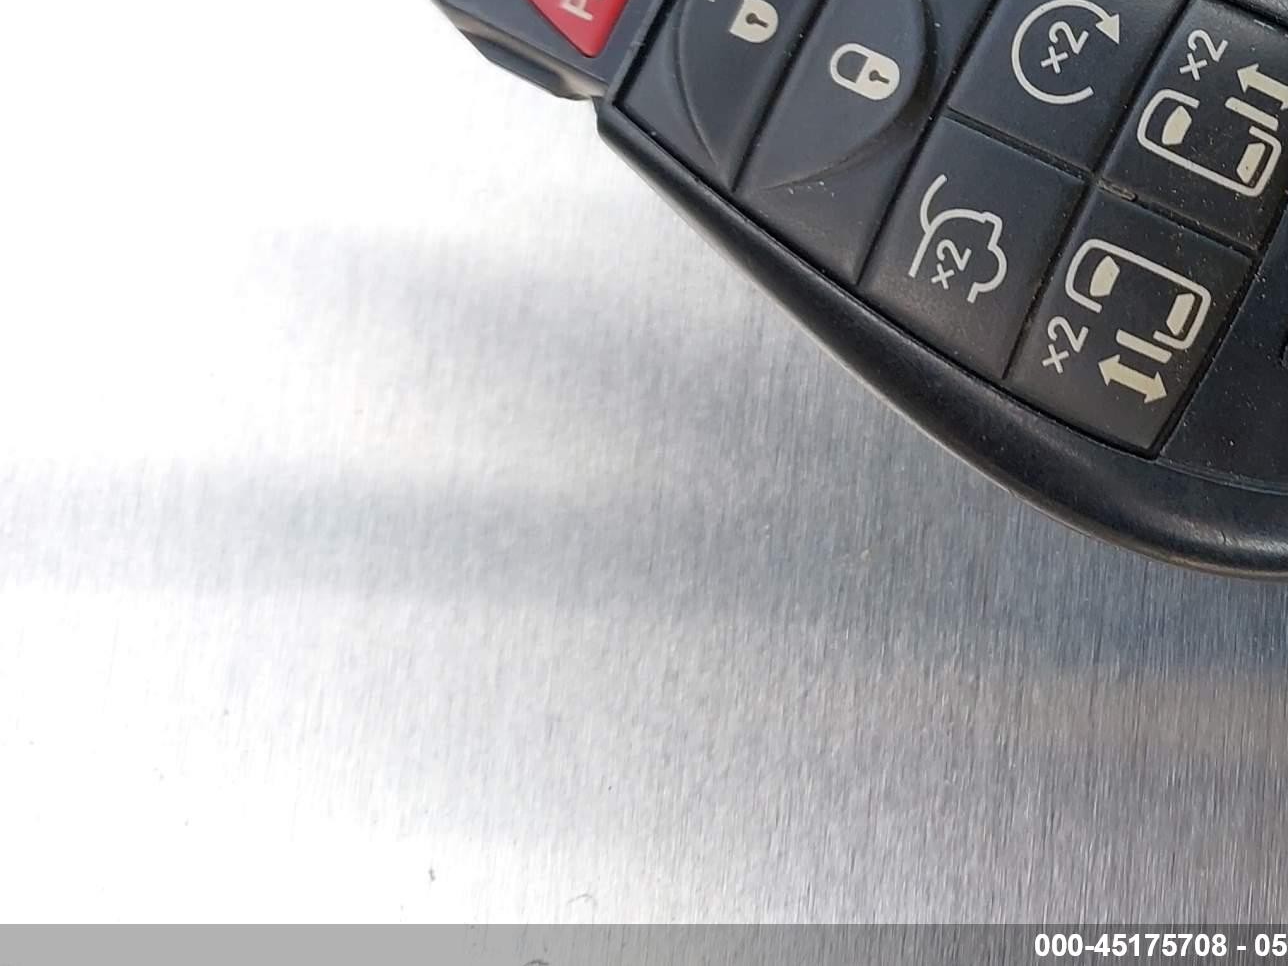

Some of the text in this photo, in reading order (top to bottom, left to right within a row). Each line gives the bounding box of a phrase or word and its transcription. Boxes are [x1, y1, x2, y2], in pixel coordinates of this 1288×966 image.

[1040, 21, 1089, 73] x2
[1179, 29, 1228, 81] x2
[931, 239, 972, 289] x2
[1042, 316, 1089, 374] x2
